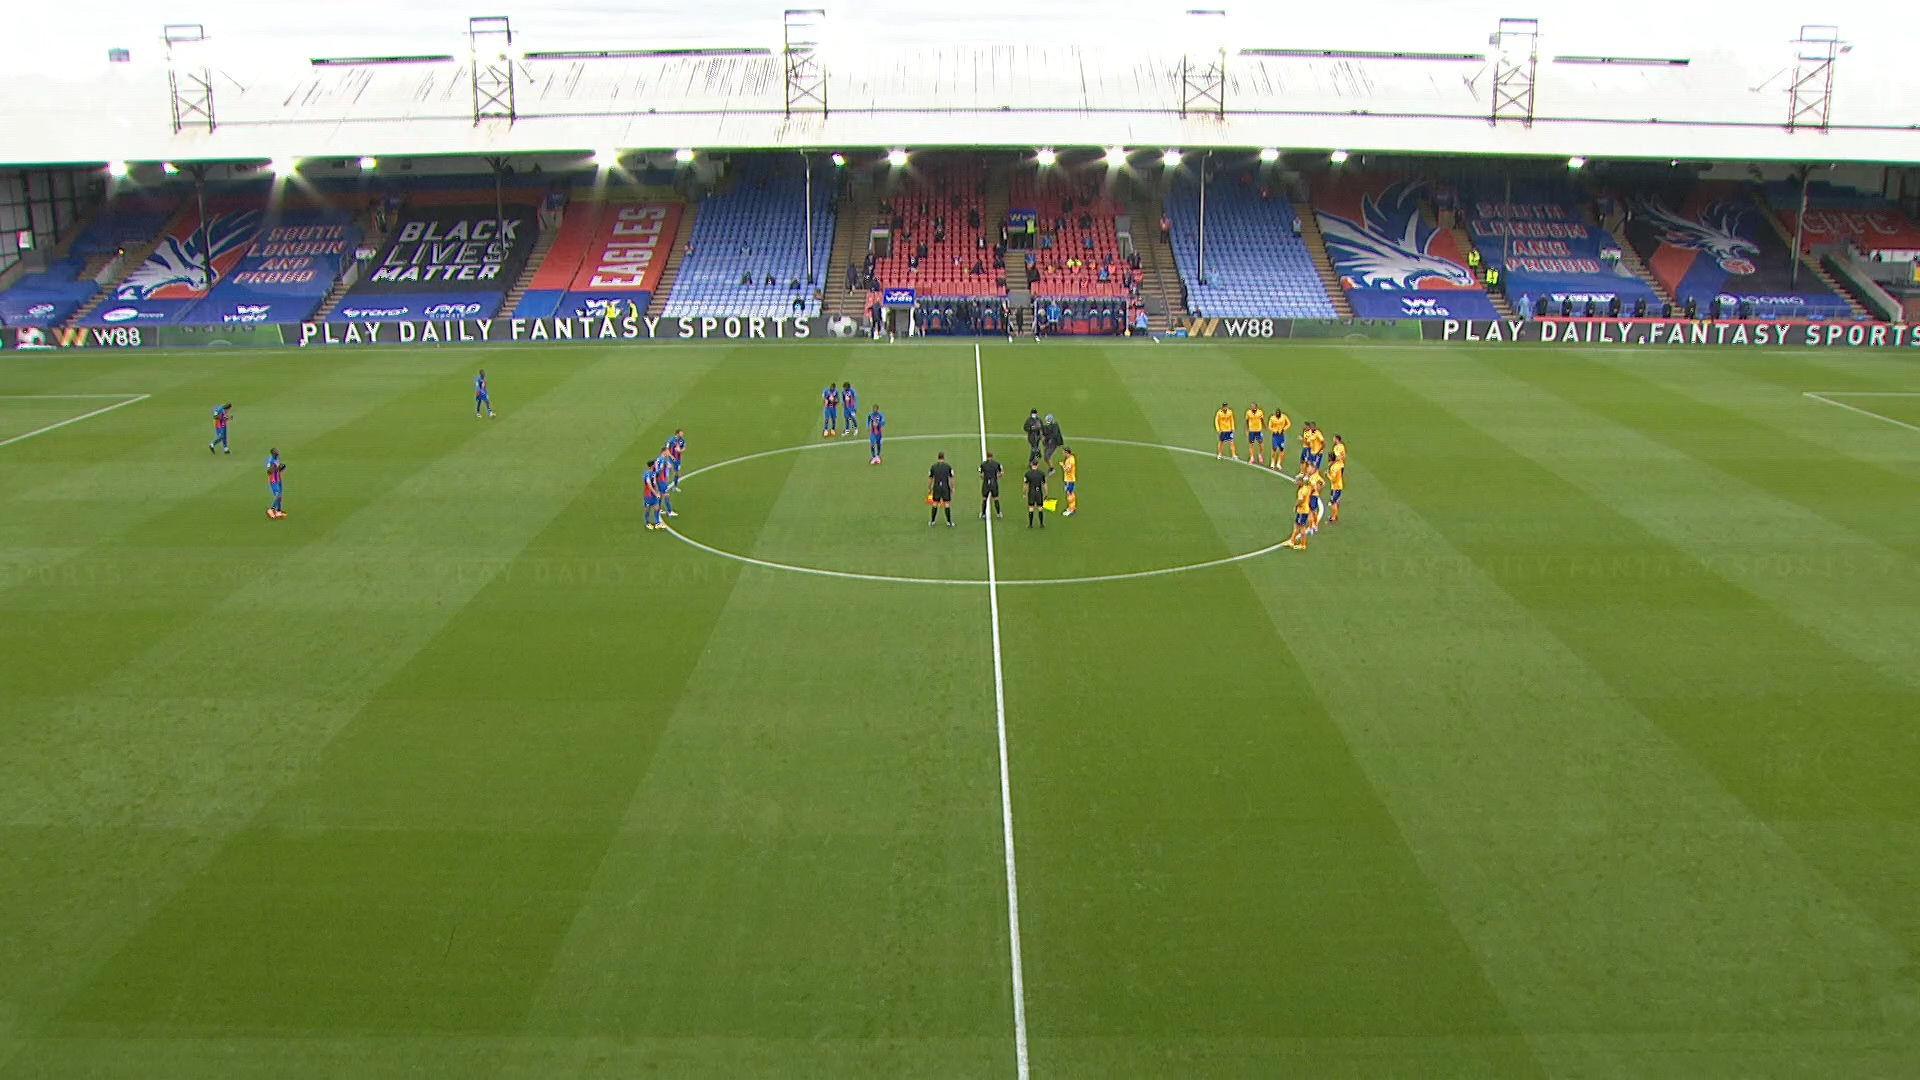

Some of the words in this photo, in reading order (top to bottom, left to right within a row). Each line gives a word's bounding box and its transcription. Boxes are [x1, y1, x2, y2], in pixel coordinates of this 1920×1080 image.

[399, 219, 521, 242] BLACK
[1472, 219, 1588, 239] LONDON
[246, 240, 345, 257] LONDON
[383, 241, 513, 265] LIVES
[589, 207, 666, 287] EAGLES
[1513, 240, 1571, 257] AND
[258, 257, 312, 270] AND
[371, 264, 501, 282] MATTER
[1505, 258, 1600, 273] PROUD
[233, 270, 317, 284] PROUD
[92, 327, 141, 347] W88
[301, 320, 381, 344] PLAY
[398, 319, 493, 343] DAILY
[511, 317, 660, 340] FANTASY
[678, 316, 810, 339] SPORTS
[1224, 318, 1274, 338] W88
[1442, 319, 1524, 342] PLAY
[1541, 321, 1632, 343] DAILY
[1649, 322, 1790, 345] FANTASY
[1805, 323, 1920, 348] SPORTS
